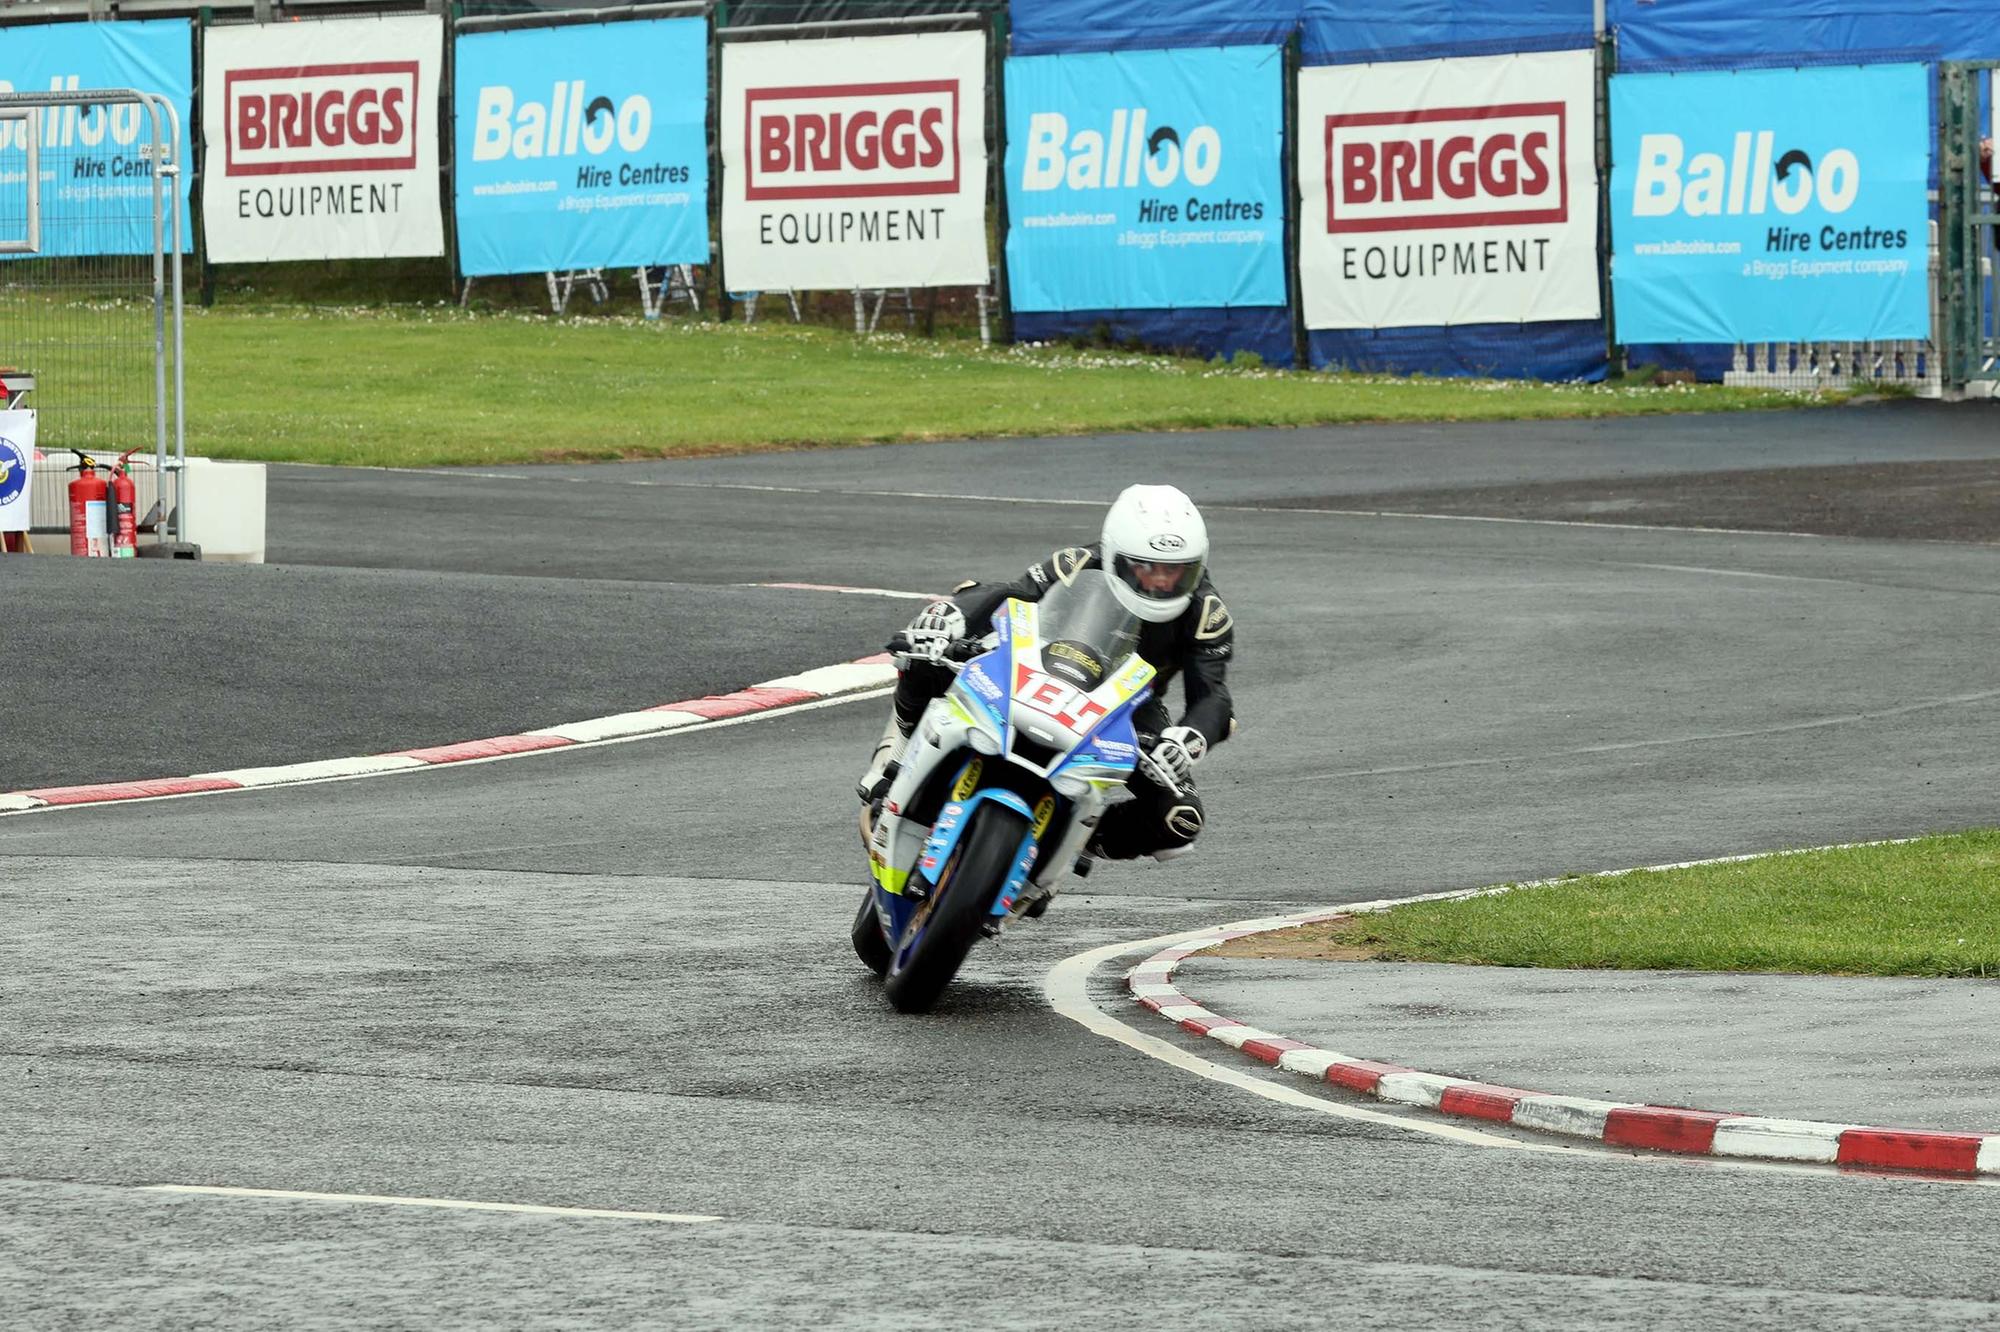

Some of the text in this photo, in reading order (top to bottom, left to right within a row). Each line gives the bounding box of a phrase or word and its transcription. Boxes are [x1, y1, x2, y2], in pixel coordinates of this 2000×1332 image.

[239, 88, 403, 149] BRIGGS
[473, 80, 652, 162] Balloo
[760, 108, 943, 173] BRIGGS
[1022, 109, 1221, 191] Balloo
[74, 157, 106, 178] Hire
[576, 163, 690, 189] Hire Centres
[1342, 132, 1548, 204] BRIGGS
[1632, 130, 1860, 217] Balloo
[239, 183, 404, 218] EQUIPMENT
[566, 195, 593, 213] Briggs
[594, 193, 646, 211] Equipment
[646, 191, 690, 208] company
[1138, 197, 1264, 224] Hire Centres
[760, 208, 946, 245] EQUIPMENT
[1126, 230, 1159, 250] Briggs
[1160, 228, 1215, 248] Equipment
[1216, 230, 1265, 247] company
[1766, 225, 1907, 253] Hire Centres
[1343, 238, 1550, 280] EQUIPMENT
[1752, 260, 1789, 281] Briggs
[1790, 258, 1853, 279] Equipment
[1855, 259, 1908, 277] company
